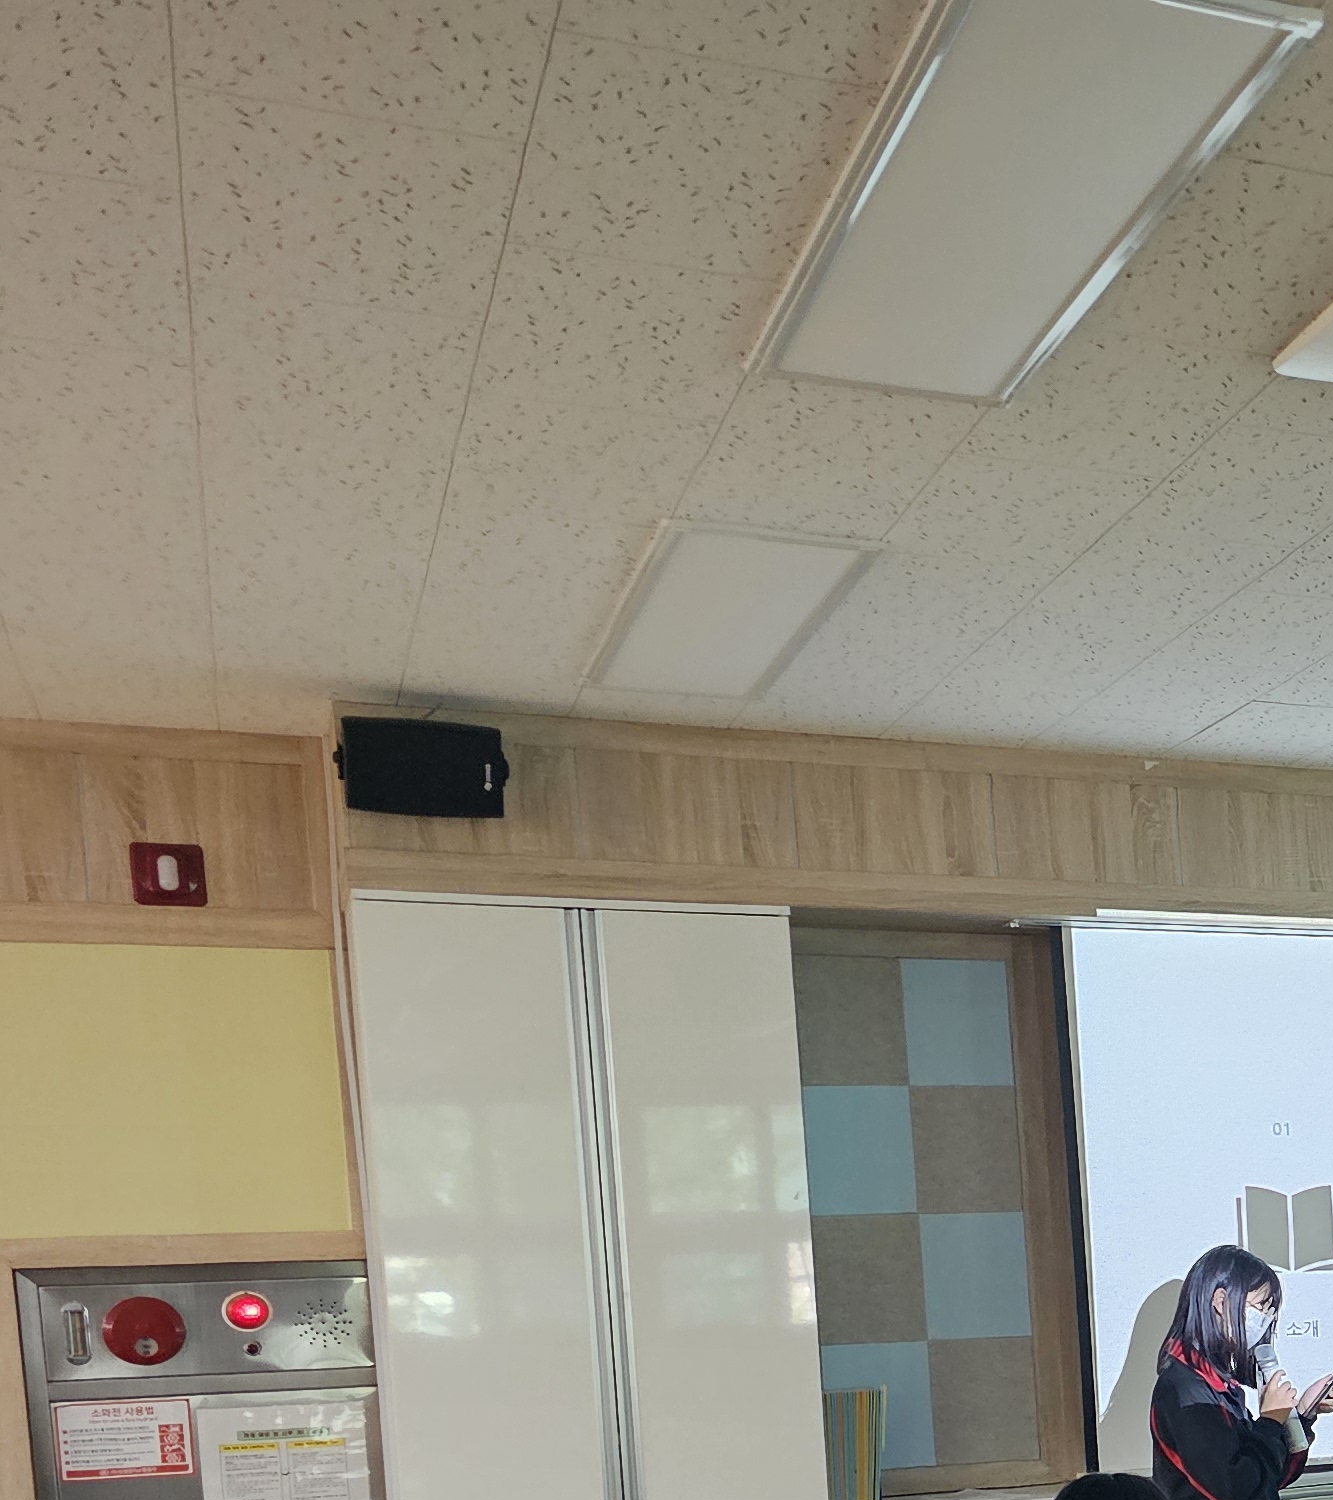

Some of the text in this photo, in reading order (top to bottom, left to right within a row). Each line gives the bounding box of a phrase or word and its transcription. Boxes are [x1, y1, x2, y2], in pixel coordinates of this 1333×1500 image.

[1272, 1122, 1291, 1136] 01
[1286, 1319, 1320, 1338] 소개
[91, 1406, 155, 1417] 소화전 사용법
